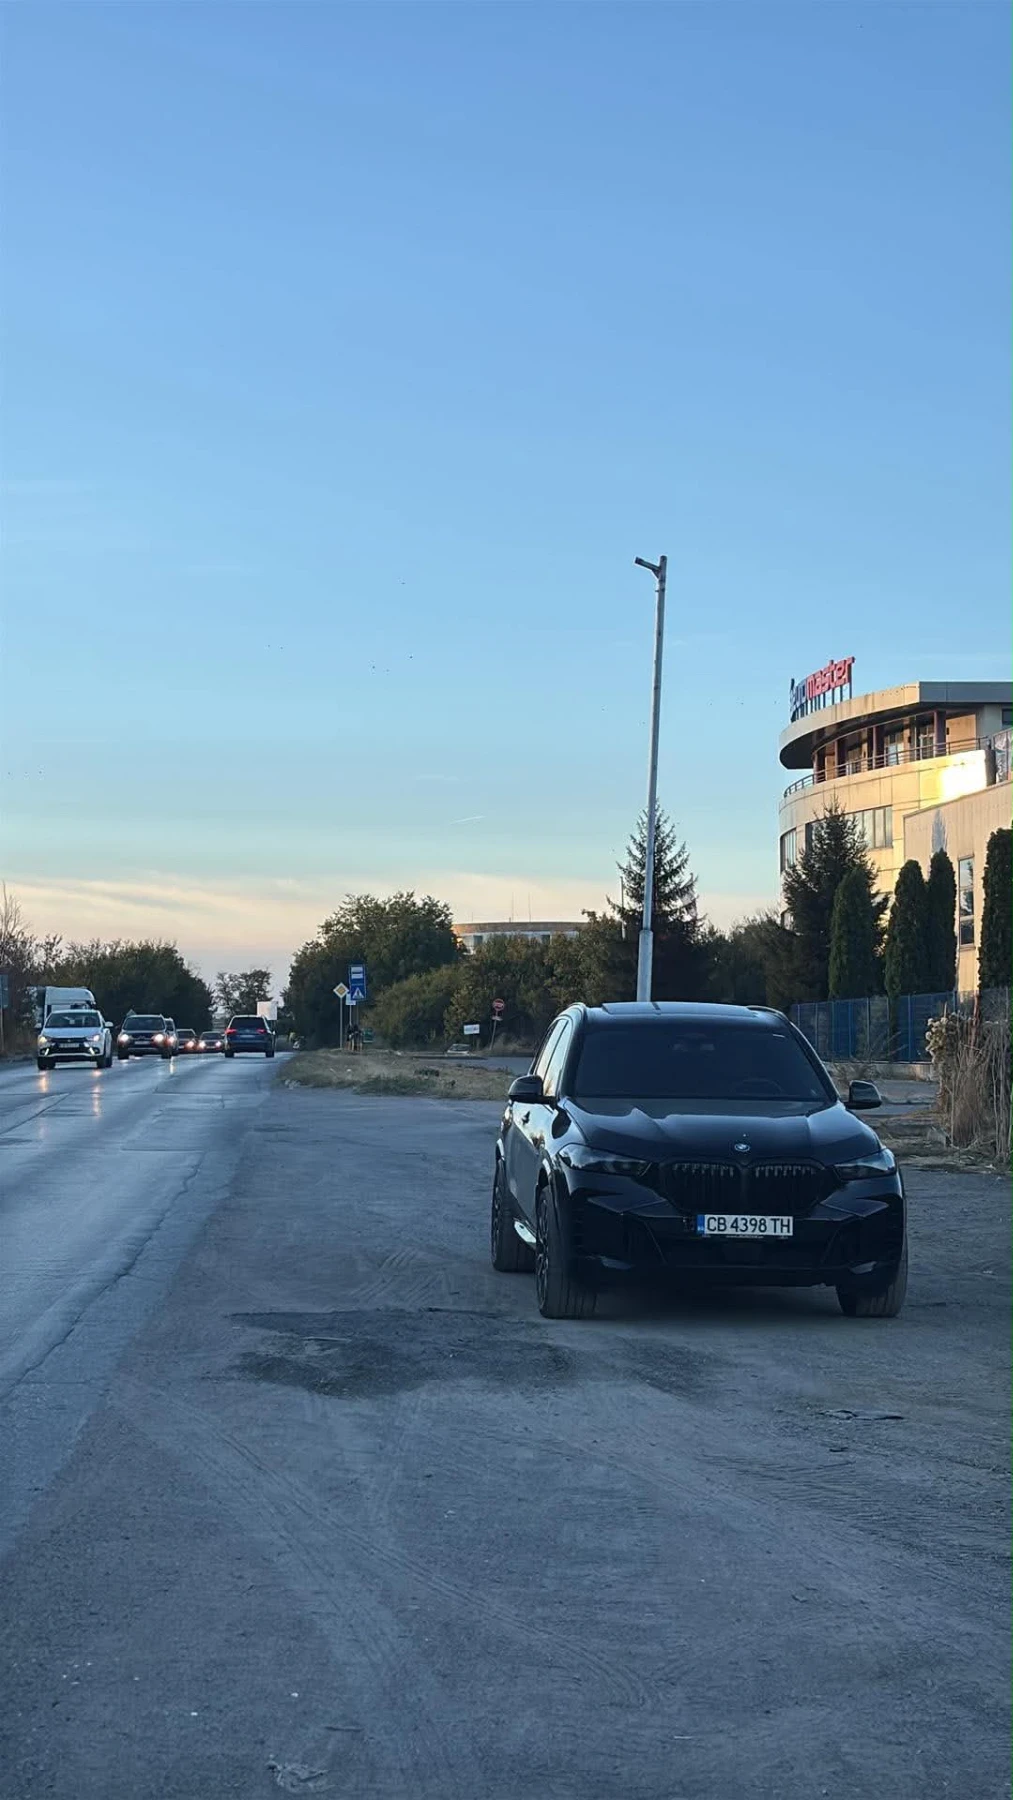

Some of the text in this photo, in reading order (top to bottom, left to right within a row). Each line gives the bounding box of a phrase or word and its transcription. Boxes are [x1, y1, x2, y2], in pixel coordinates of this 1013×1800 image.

[707, 1216, 791, 1234] CB 4398 TH
